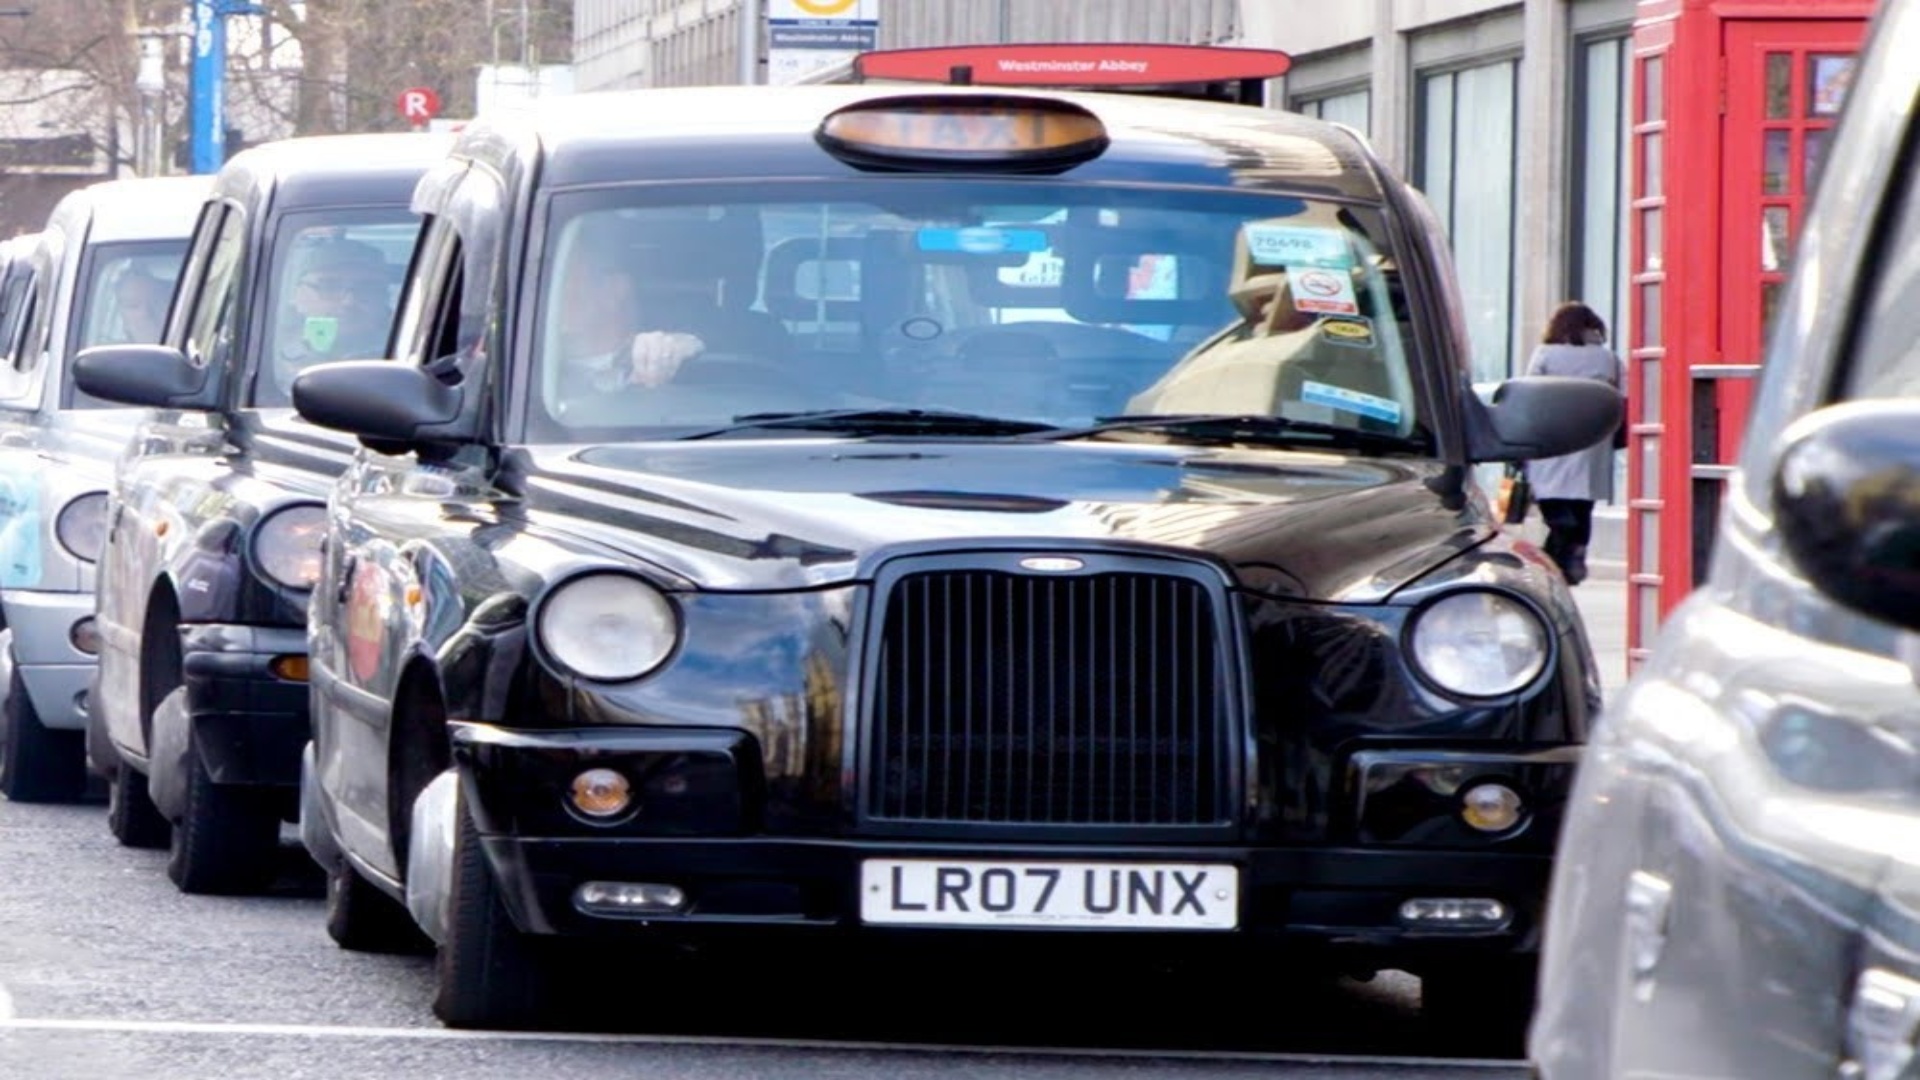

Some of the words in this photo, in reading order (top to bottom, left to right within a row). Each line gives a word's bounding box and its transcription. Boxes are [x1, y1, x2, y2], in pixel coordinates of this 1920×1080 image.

[998, 60, 1096, 72] Westminster
[1098, 60, 1148, 73] Abbey
[405, 92, 429, 117] R
[896, 112, 1046, 146] TAXI
[891, 866, 1061, 914] LR07
[1084, 869, 1208, 917] UNX
